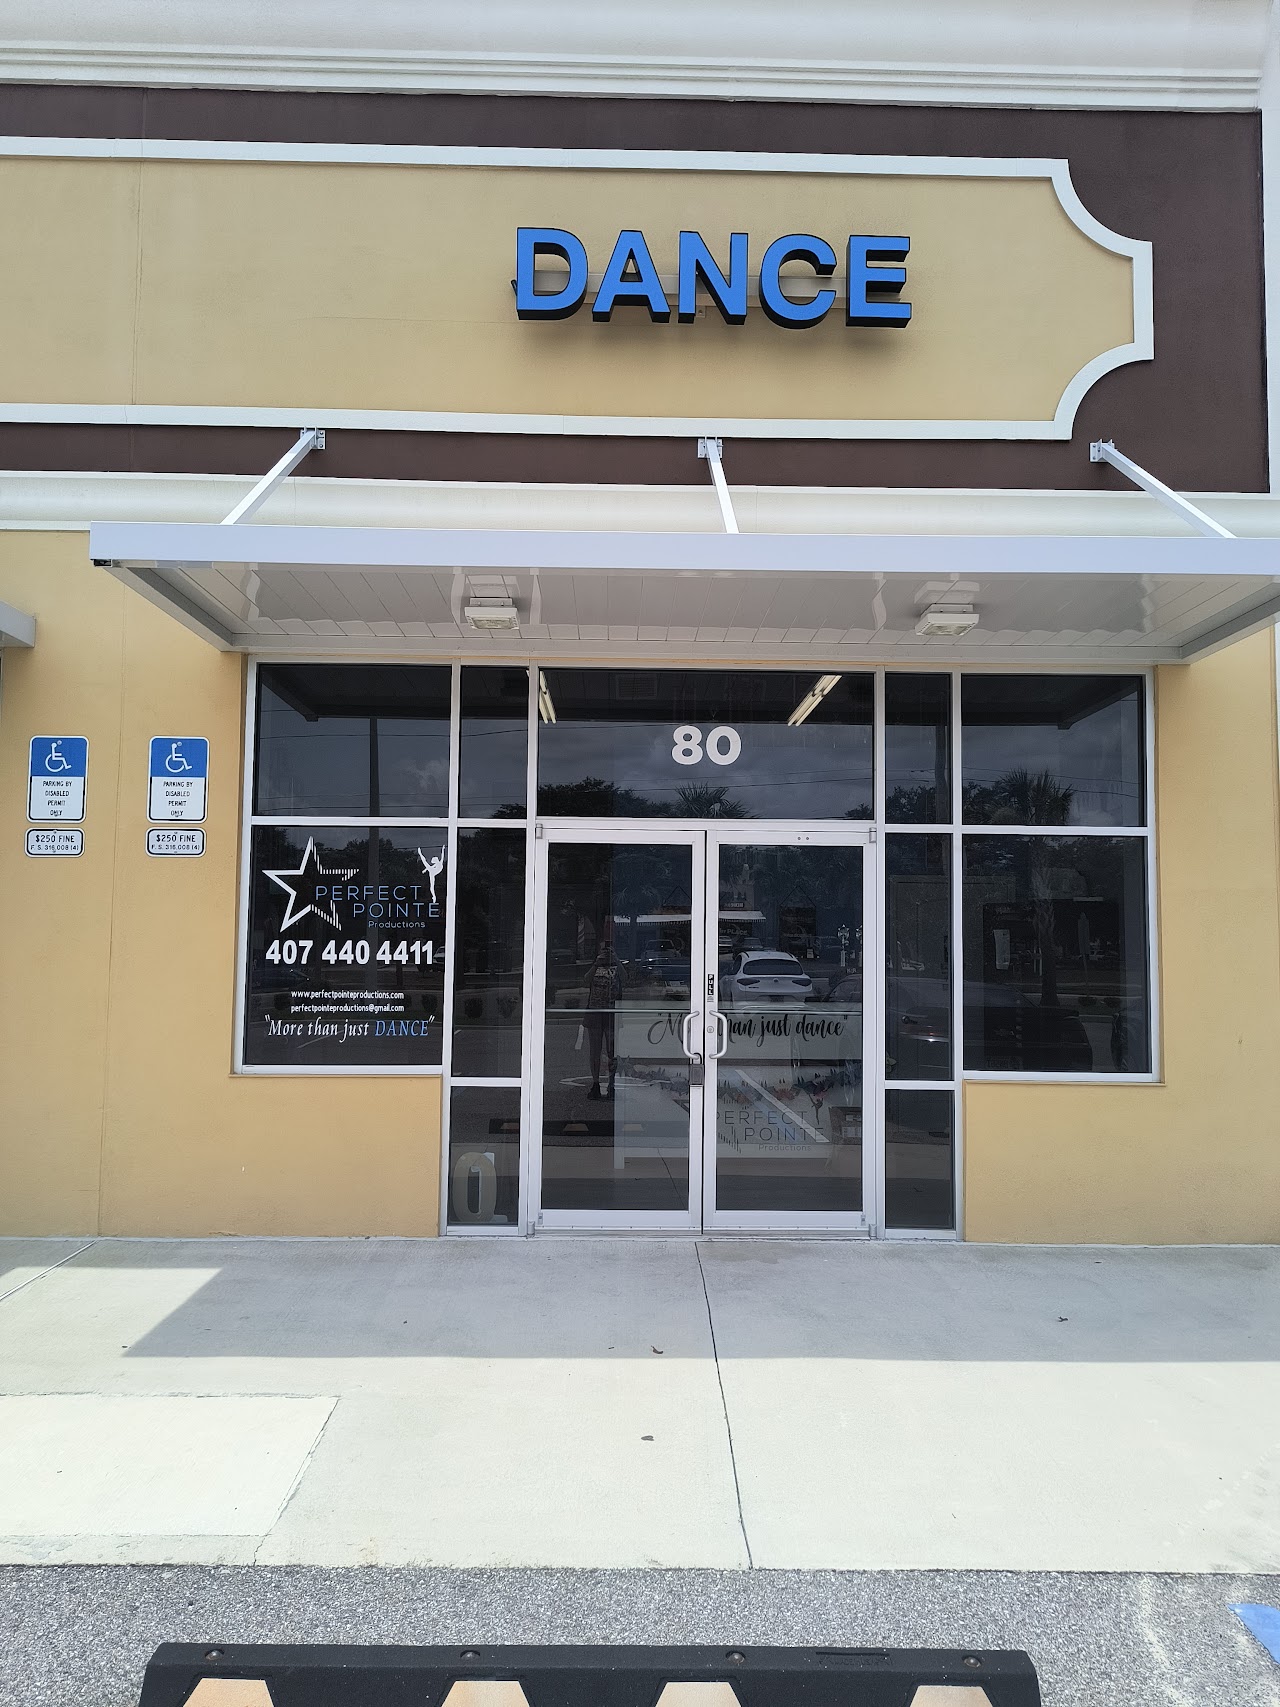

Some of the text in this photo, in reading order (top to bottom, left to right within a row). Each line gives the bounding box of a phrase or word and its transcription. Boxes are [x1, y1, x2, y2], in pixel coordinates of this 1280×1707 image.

[516, 227, 911, 329] DANCE
[672, 725, 742, 765] 80
[35, 834, 75, 843] $250 FINE
[156, 834, 196, 843] $250 FINE
[315, 885, 422, 900] PERFECT
[353, 902, 440, 918] POINTE
[368, 920, 426, 929] Productions
[265, 939, 434, 965] 407 440 4411
[707, 973, 715, 995] PULL
[290, 989, 405, 1000] www.perfectpointeproductions.com
[290, 1003, 405, 1014] perfectpointeproductions@gmail.com
[264, 1014, 435, 1043] "More than just DANCE"
[756, 1014, 791, 1047] just
[795, 1014, 848, 1042] dance"
[716, 1110, 808, 1125] ERFECT
[758, 1144, 812, 1152] Productions
